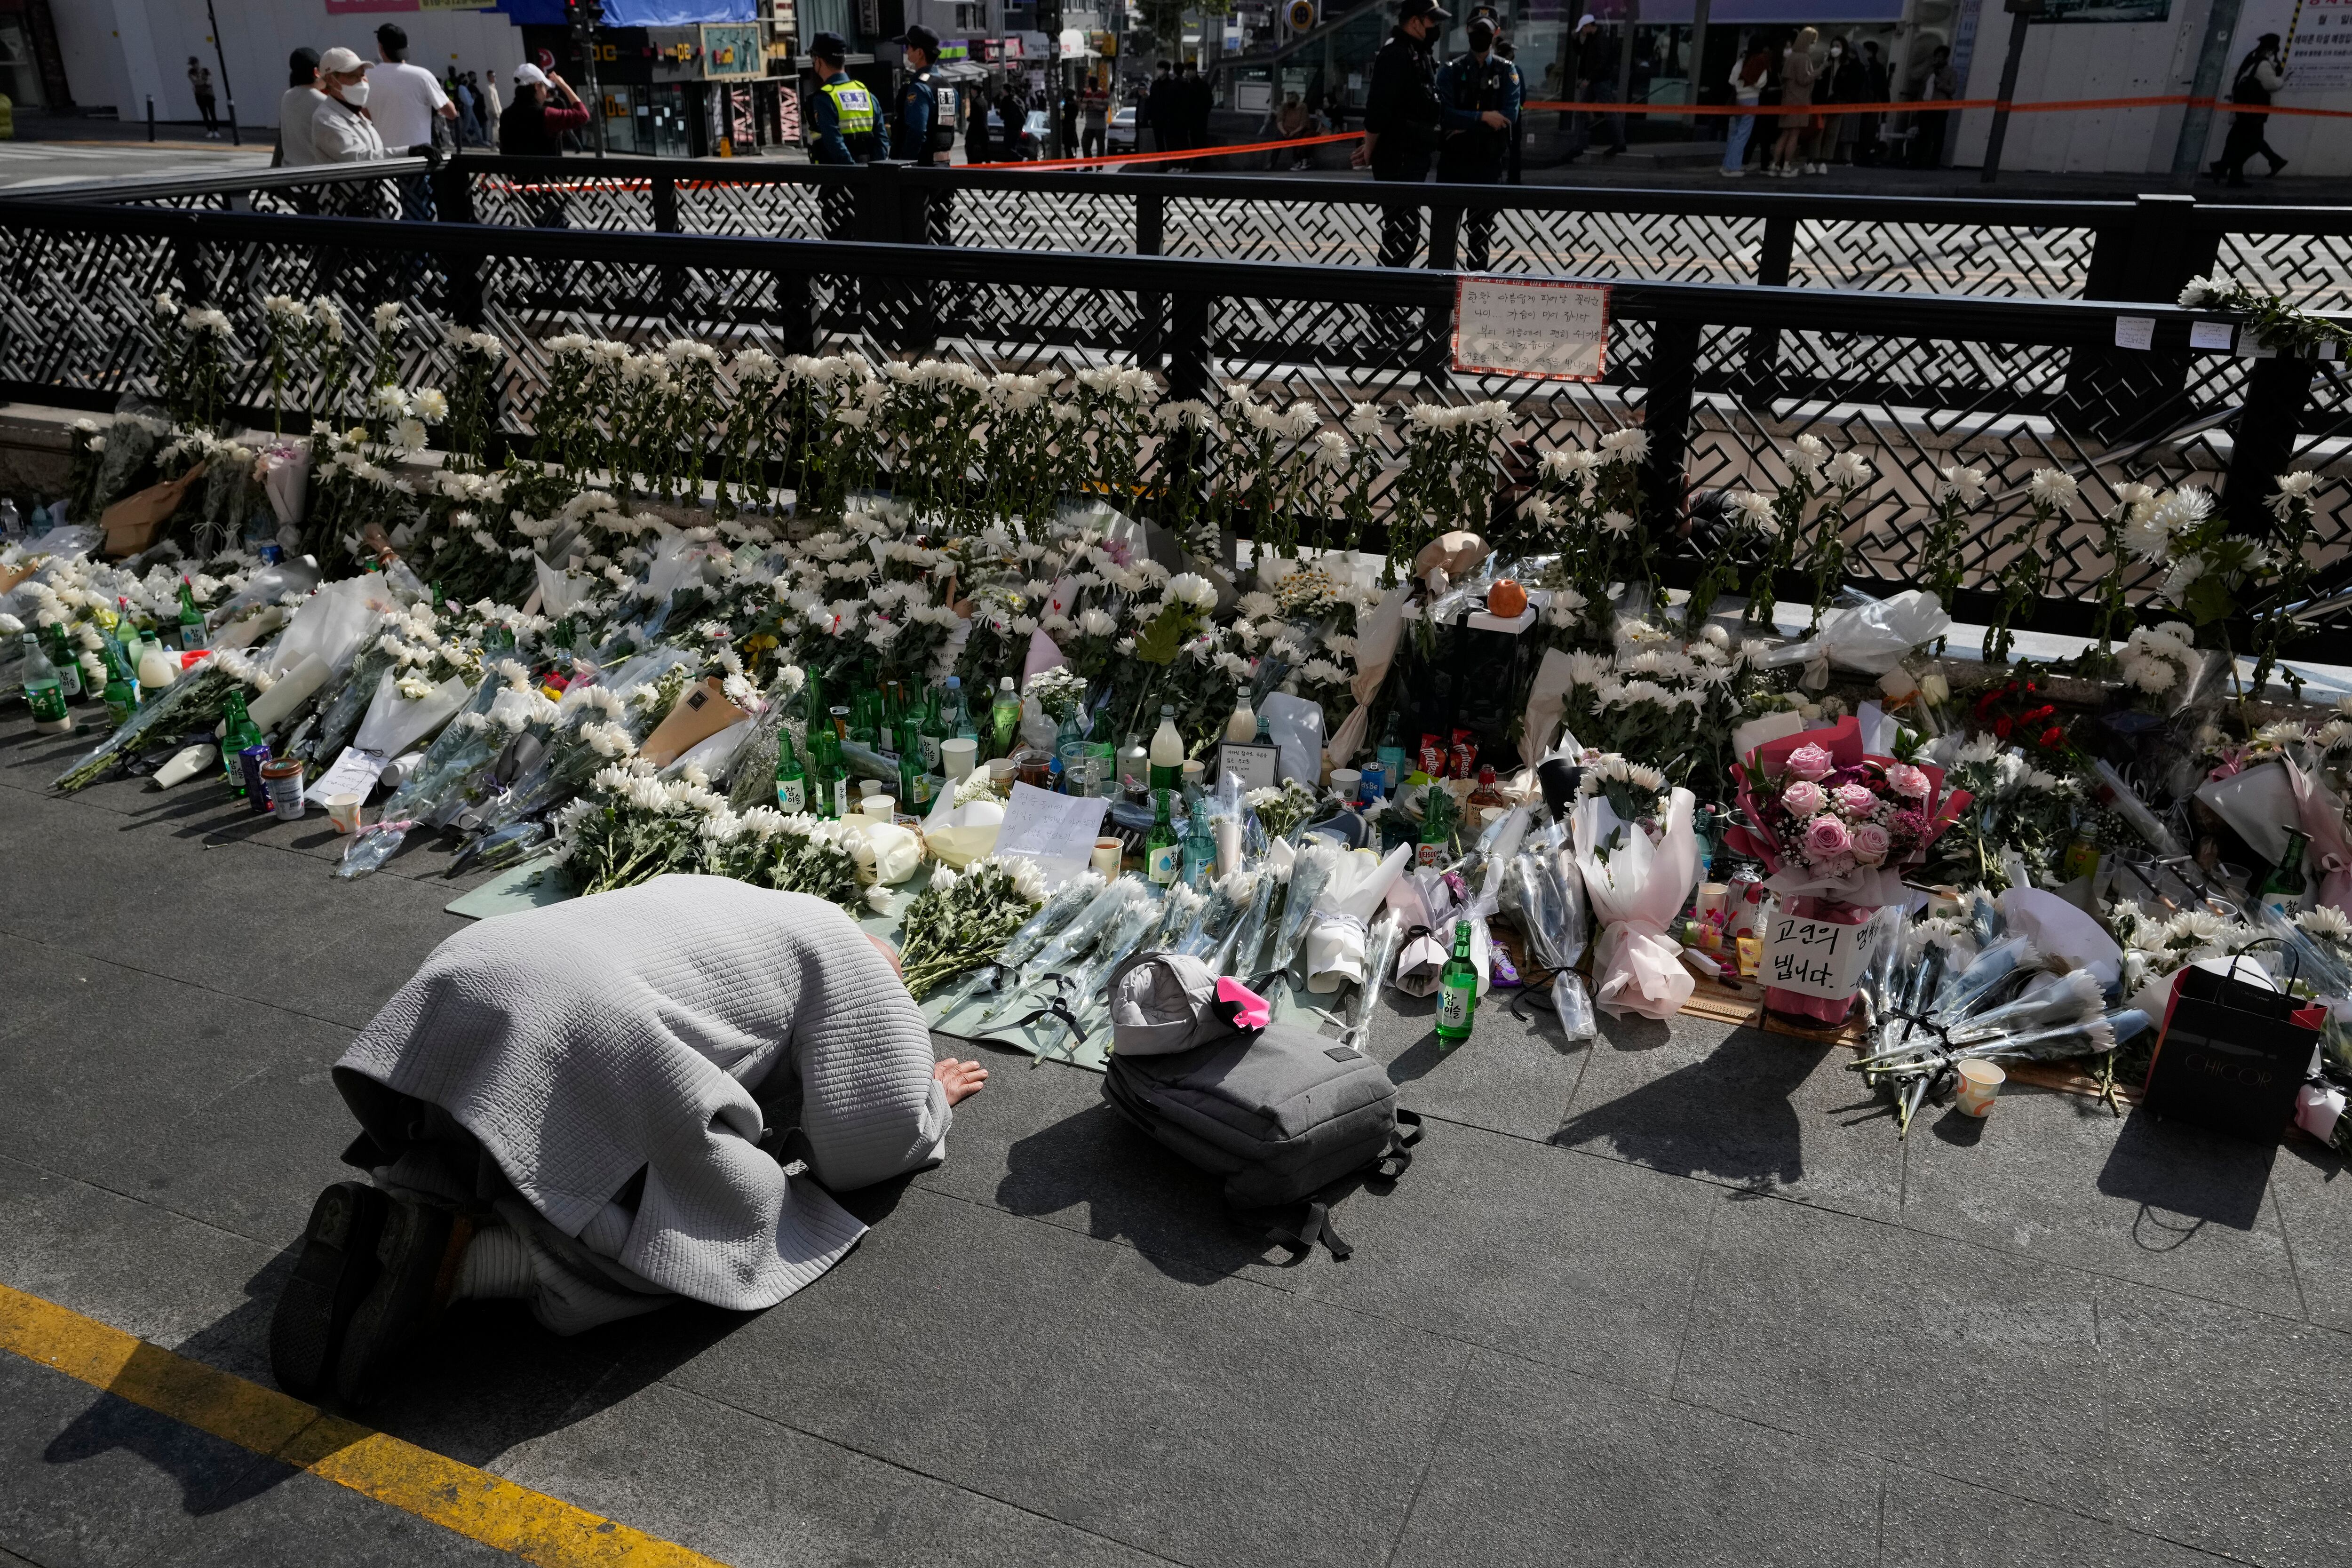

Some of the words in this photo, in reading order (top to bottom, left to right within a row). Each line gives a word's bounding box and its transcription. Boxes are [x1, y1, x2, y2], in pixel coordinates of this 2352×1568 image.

[1498, 292, 1535, 304] 아름답게
[1541, 294, 1567, 305] 피어날
[1507, 309, 1535, 321] 가슴이
[1542, 311, 1558, 322] 미어
[1477, 325, 1496, 340] 부디
[1506, 329, 1542, 338] 하늘에서
[1550, 329, 1568, 338] 편히
[1573, 329, 1600, 341] 쉬기를
[1462, 352, 1495, 364] 영혼들의
[1535, 357, 1560, 370] 안식을
[191, 629, 199, 638] 참
[60, 670, 69, 681] 참
[63, 679, 76, 688] 이슬
[923, 740, 931, 751] 참
[924, 750, 935, 761] 이슬
[229, 758, 237, 770] 참
[231, 768, 244, 779] 이슬
[785, 786, 795, 796] 참
[788, 793, 801, 805] 이슬
[2285, 900, 2298, 913] 참
[1774, 954, 1834, 988] 빕니다.
[1445, 991, 1457, 1006] 참
[1445, 1005, 1461, 1019] 이슬
[2185, 1053, 2272, 1090] CHICOR
